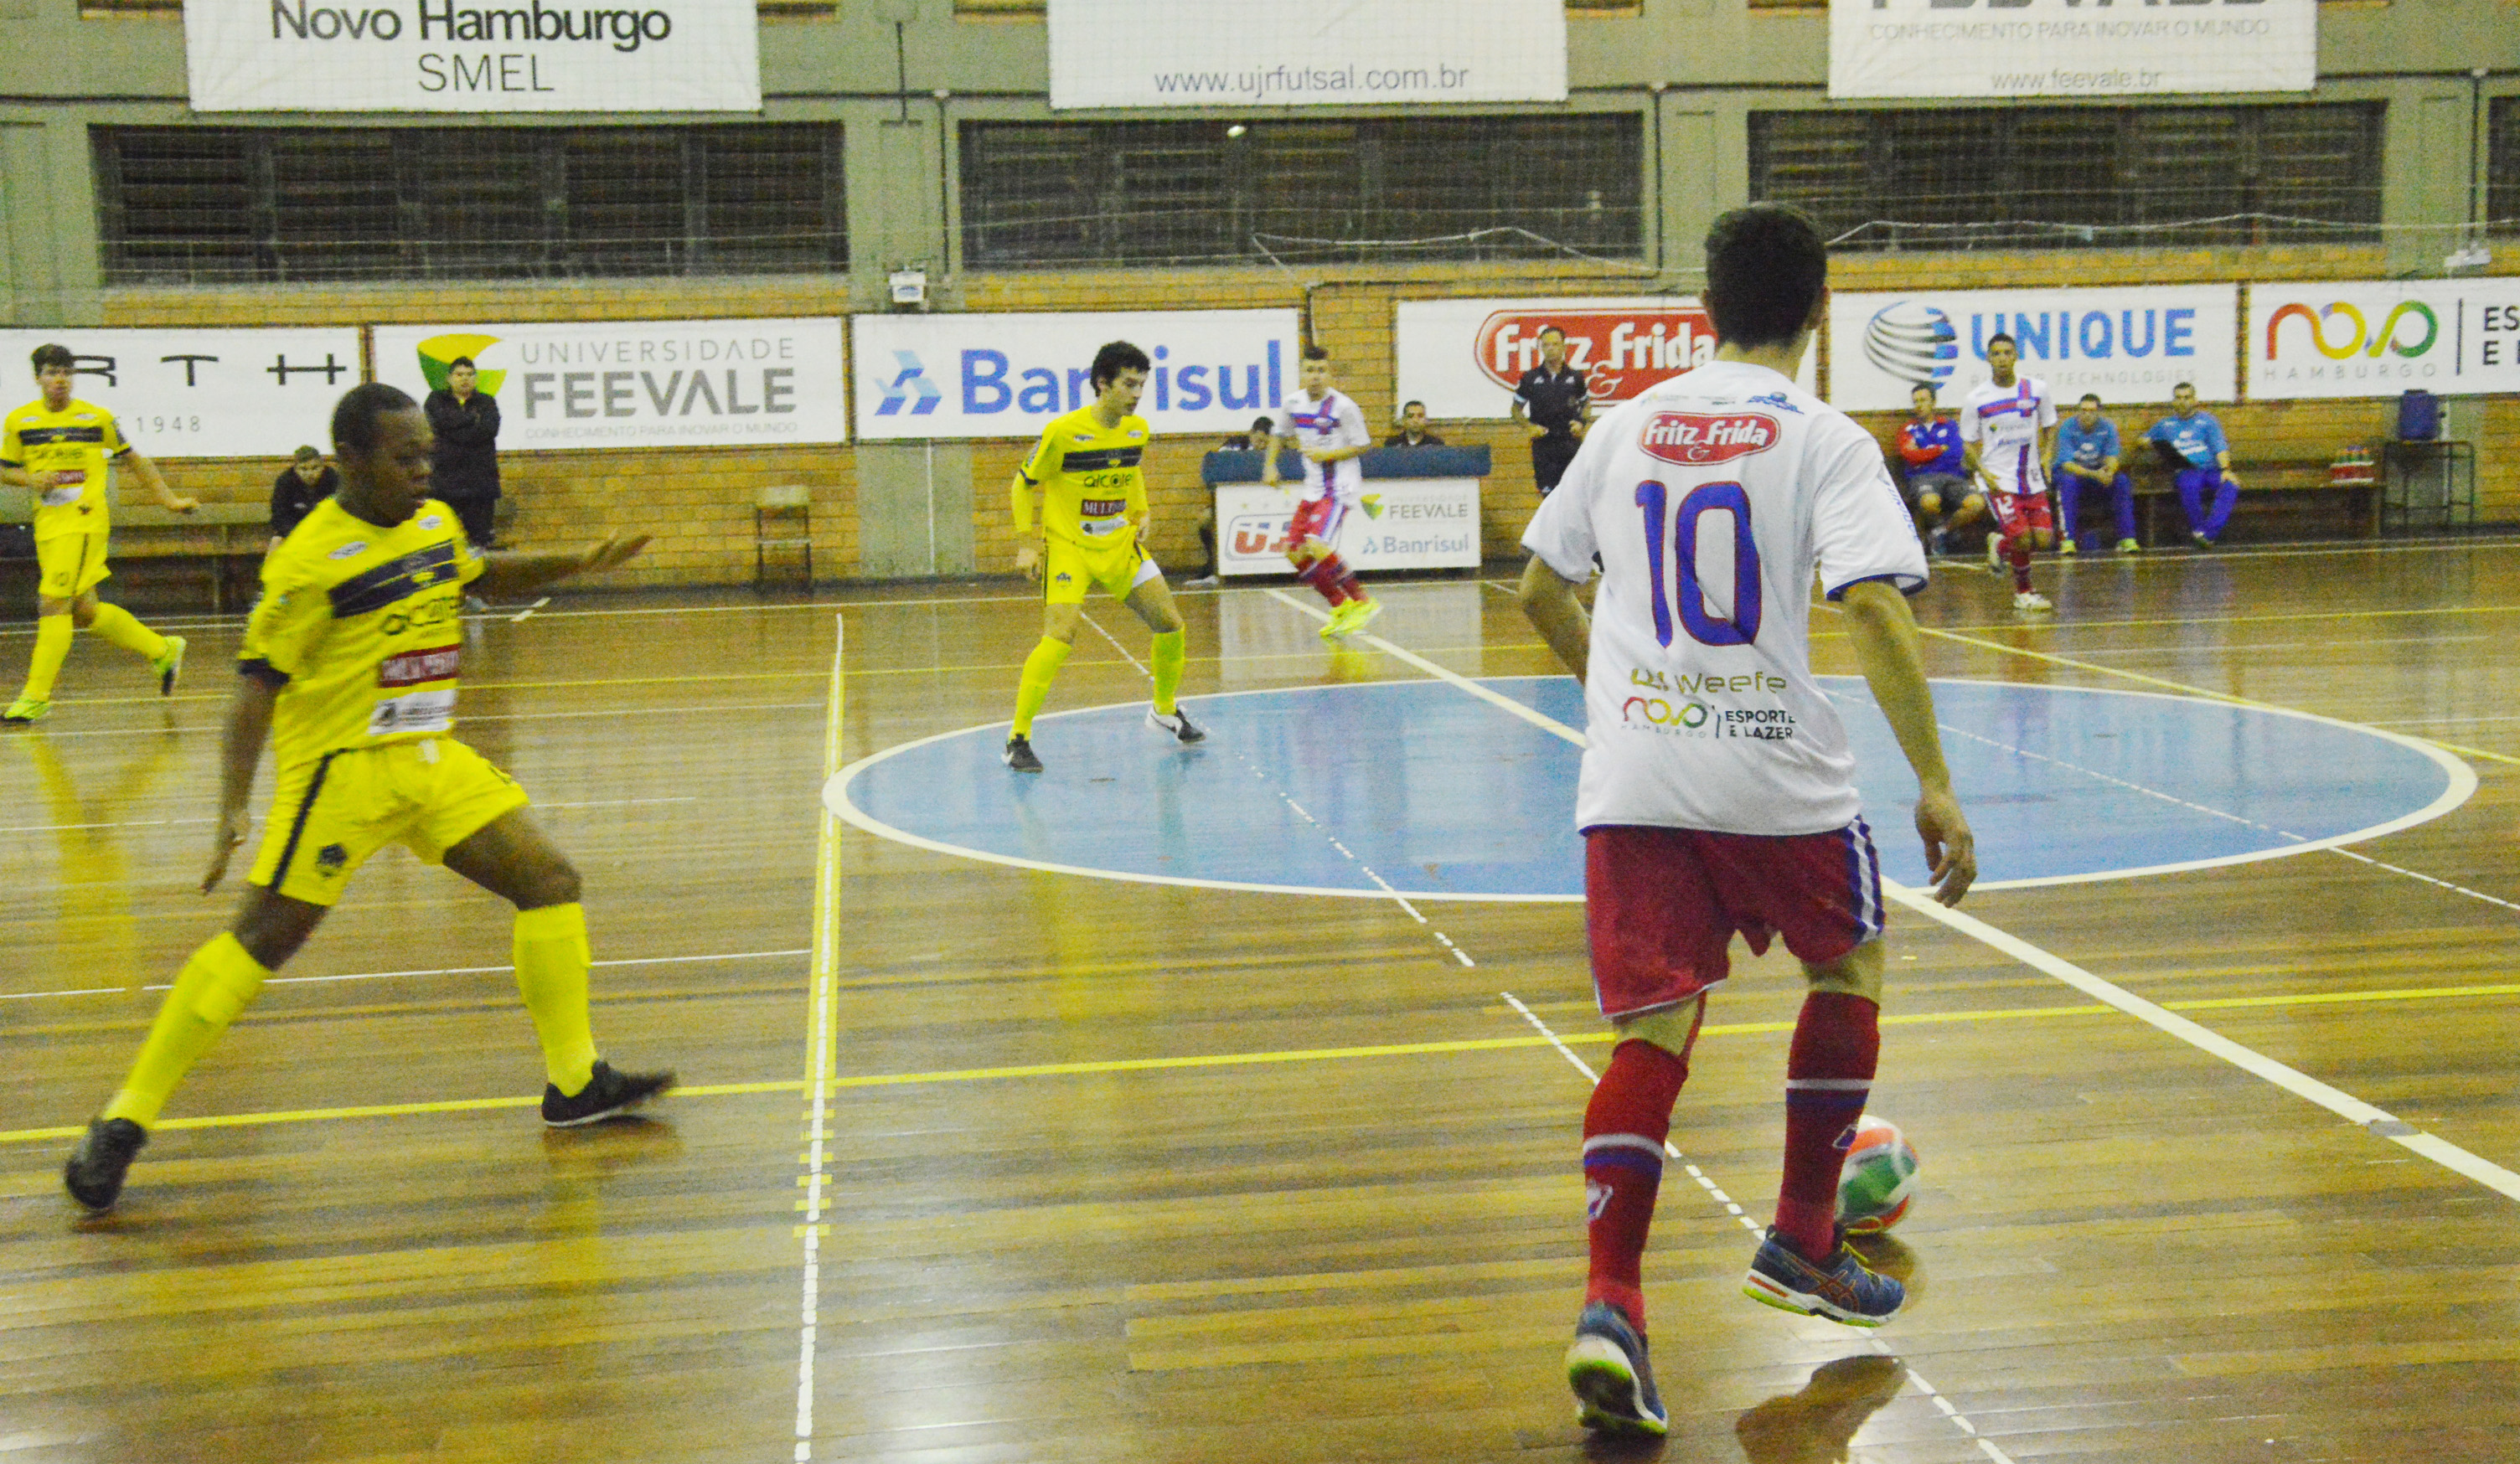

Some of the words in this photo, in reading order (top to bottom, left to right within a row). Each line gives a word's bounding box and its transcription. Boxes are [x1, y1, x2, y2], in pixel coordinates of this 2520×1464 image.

[271, 0, 402, 39] Novo
[419, 0, 671, 51] Hamburgo
[1870, 23, 2032, 40] CONHECIMENTO
[2037, 22, 2089, 39] PARA
[2096, 21, 2168, 39] INOVAR
[2175, 20, 2188, 37] O
[2198, 19, 2270, 37] MUNDO
[418, 54, 555, 92] SMEL
[1154, 63, 1469, 98] www.ujrfutsal.com.br
[1991, 68, 2161, 90] www.feevale.br
[1971, 308, 2195, 360] UNIQUE
[521, 338, 794, 363] UNIVERSIDADE
[1609, 322, 1715, 370] Frida
[2057, 369, 2195, 385] TECHNOLOGIES
[2264, 363, 2436, 378] HAMBURGO
[524, 367, 797, 419] FEEVALE
[137, 416, 202, 433] 1948
[525, 425, 637, 440] CONHECIMENTO
[640, 424, 679, 437] PARA
[680, 423, 731, 436] INOVAR
[733, 422, 742, 435] O
[746, 421, 798, 435] MUNDO
[1643, 419, 1698, 446] Fritz
[1702, 420, 1770, 447] Frida
[1389, 503, 1469, 518] FEEVALE
[1383, 533, 1469, 554] Banrisul
[1635, 479, 1761, 648] 10
[1744, 725, 1794, 740] LAZER
